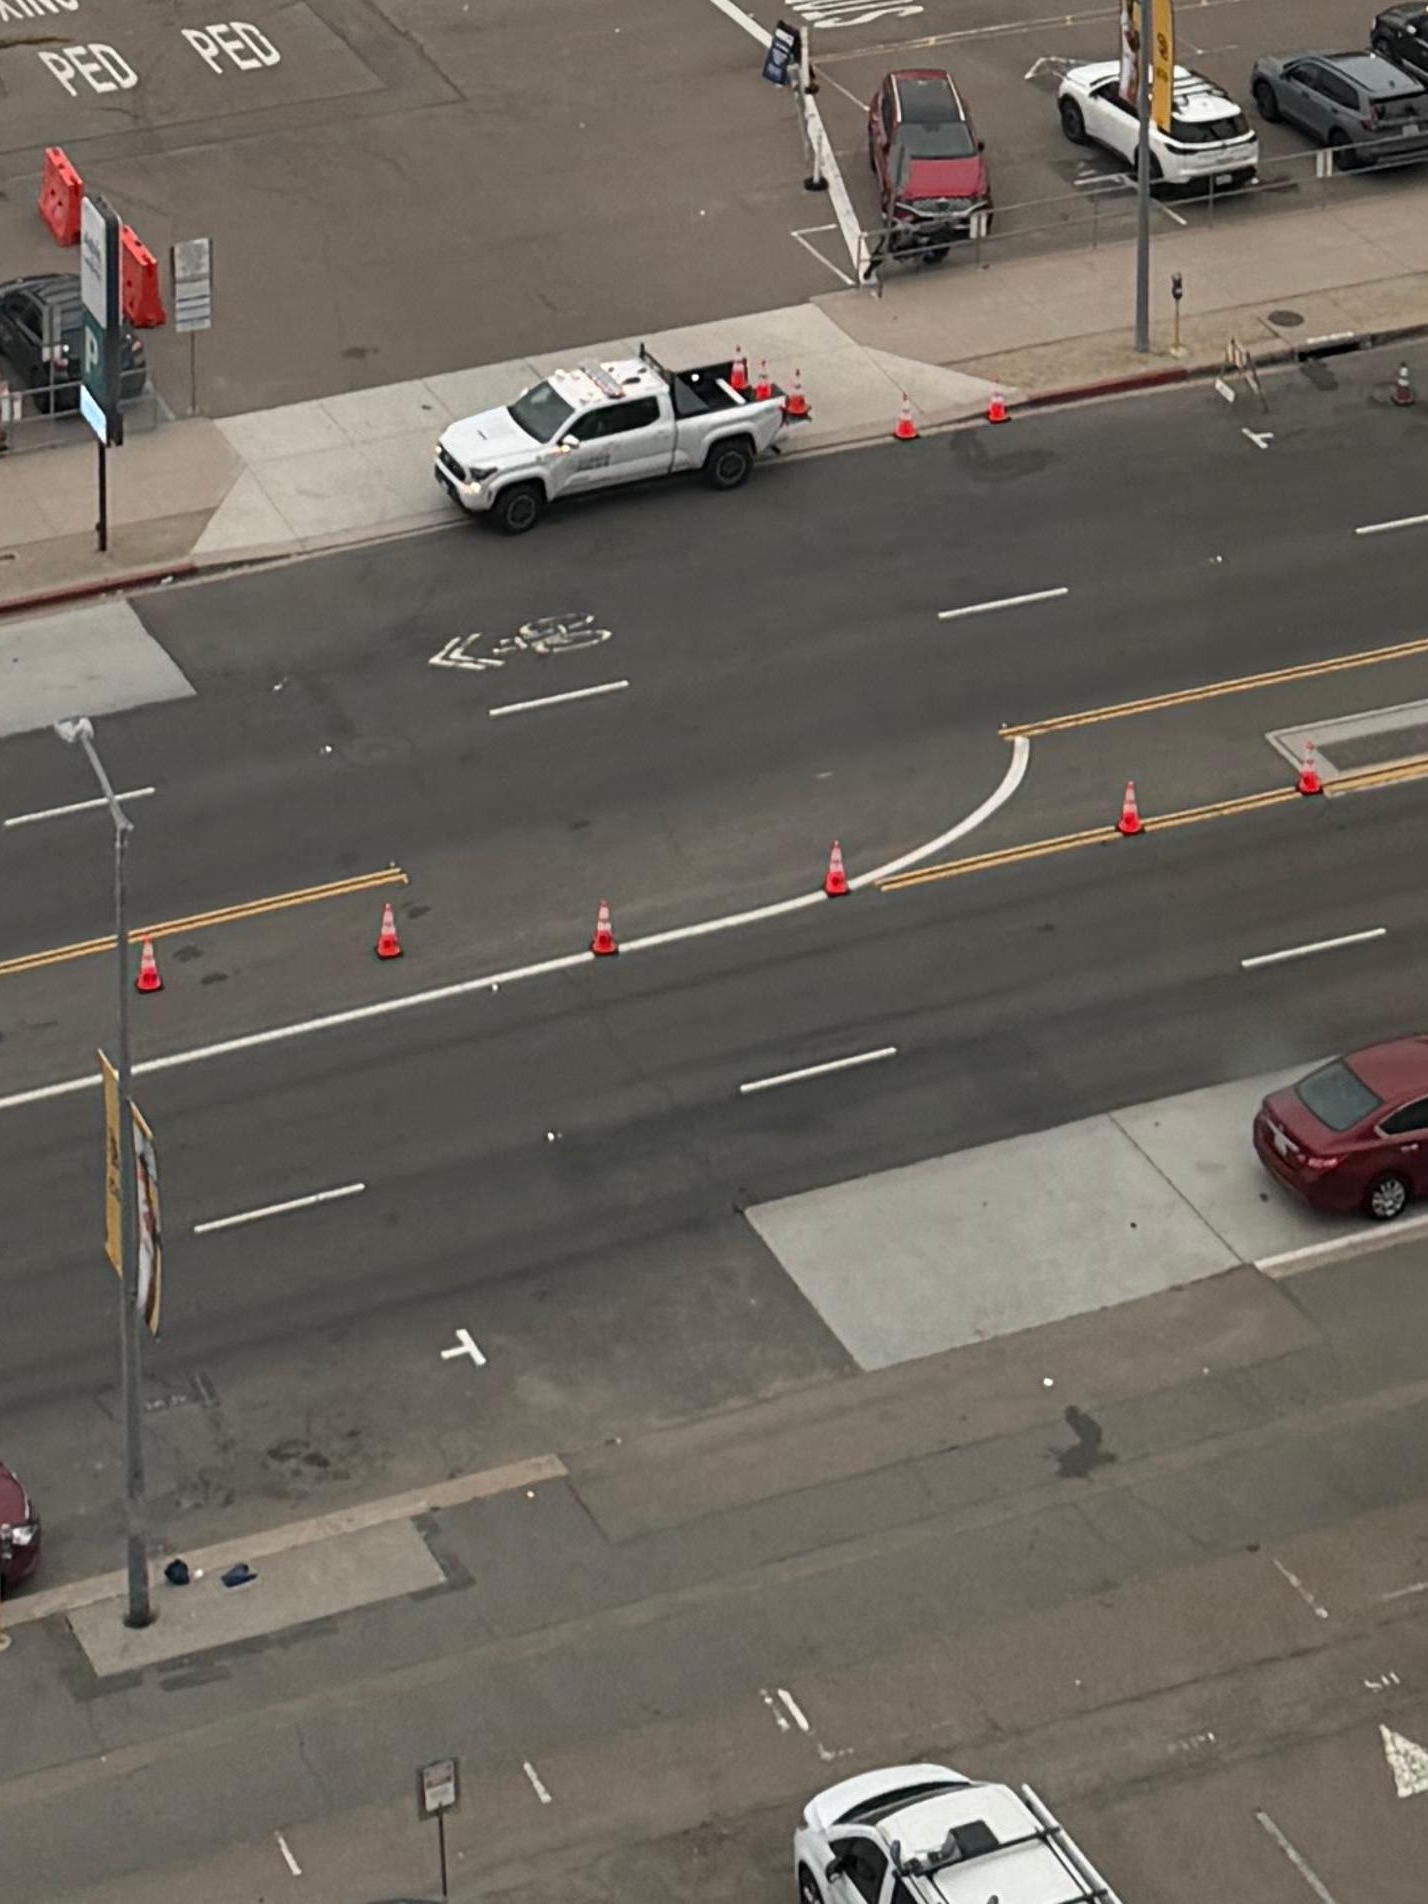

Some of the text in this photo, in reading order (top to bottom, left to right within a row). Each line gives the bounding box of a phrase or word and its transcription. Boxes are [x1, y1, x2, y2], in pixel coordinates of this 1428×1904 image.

[38, 43, 139, 97] PED
[181, 21, 281, 74] PED
[84, 325, 99, 374] P
